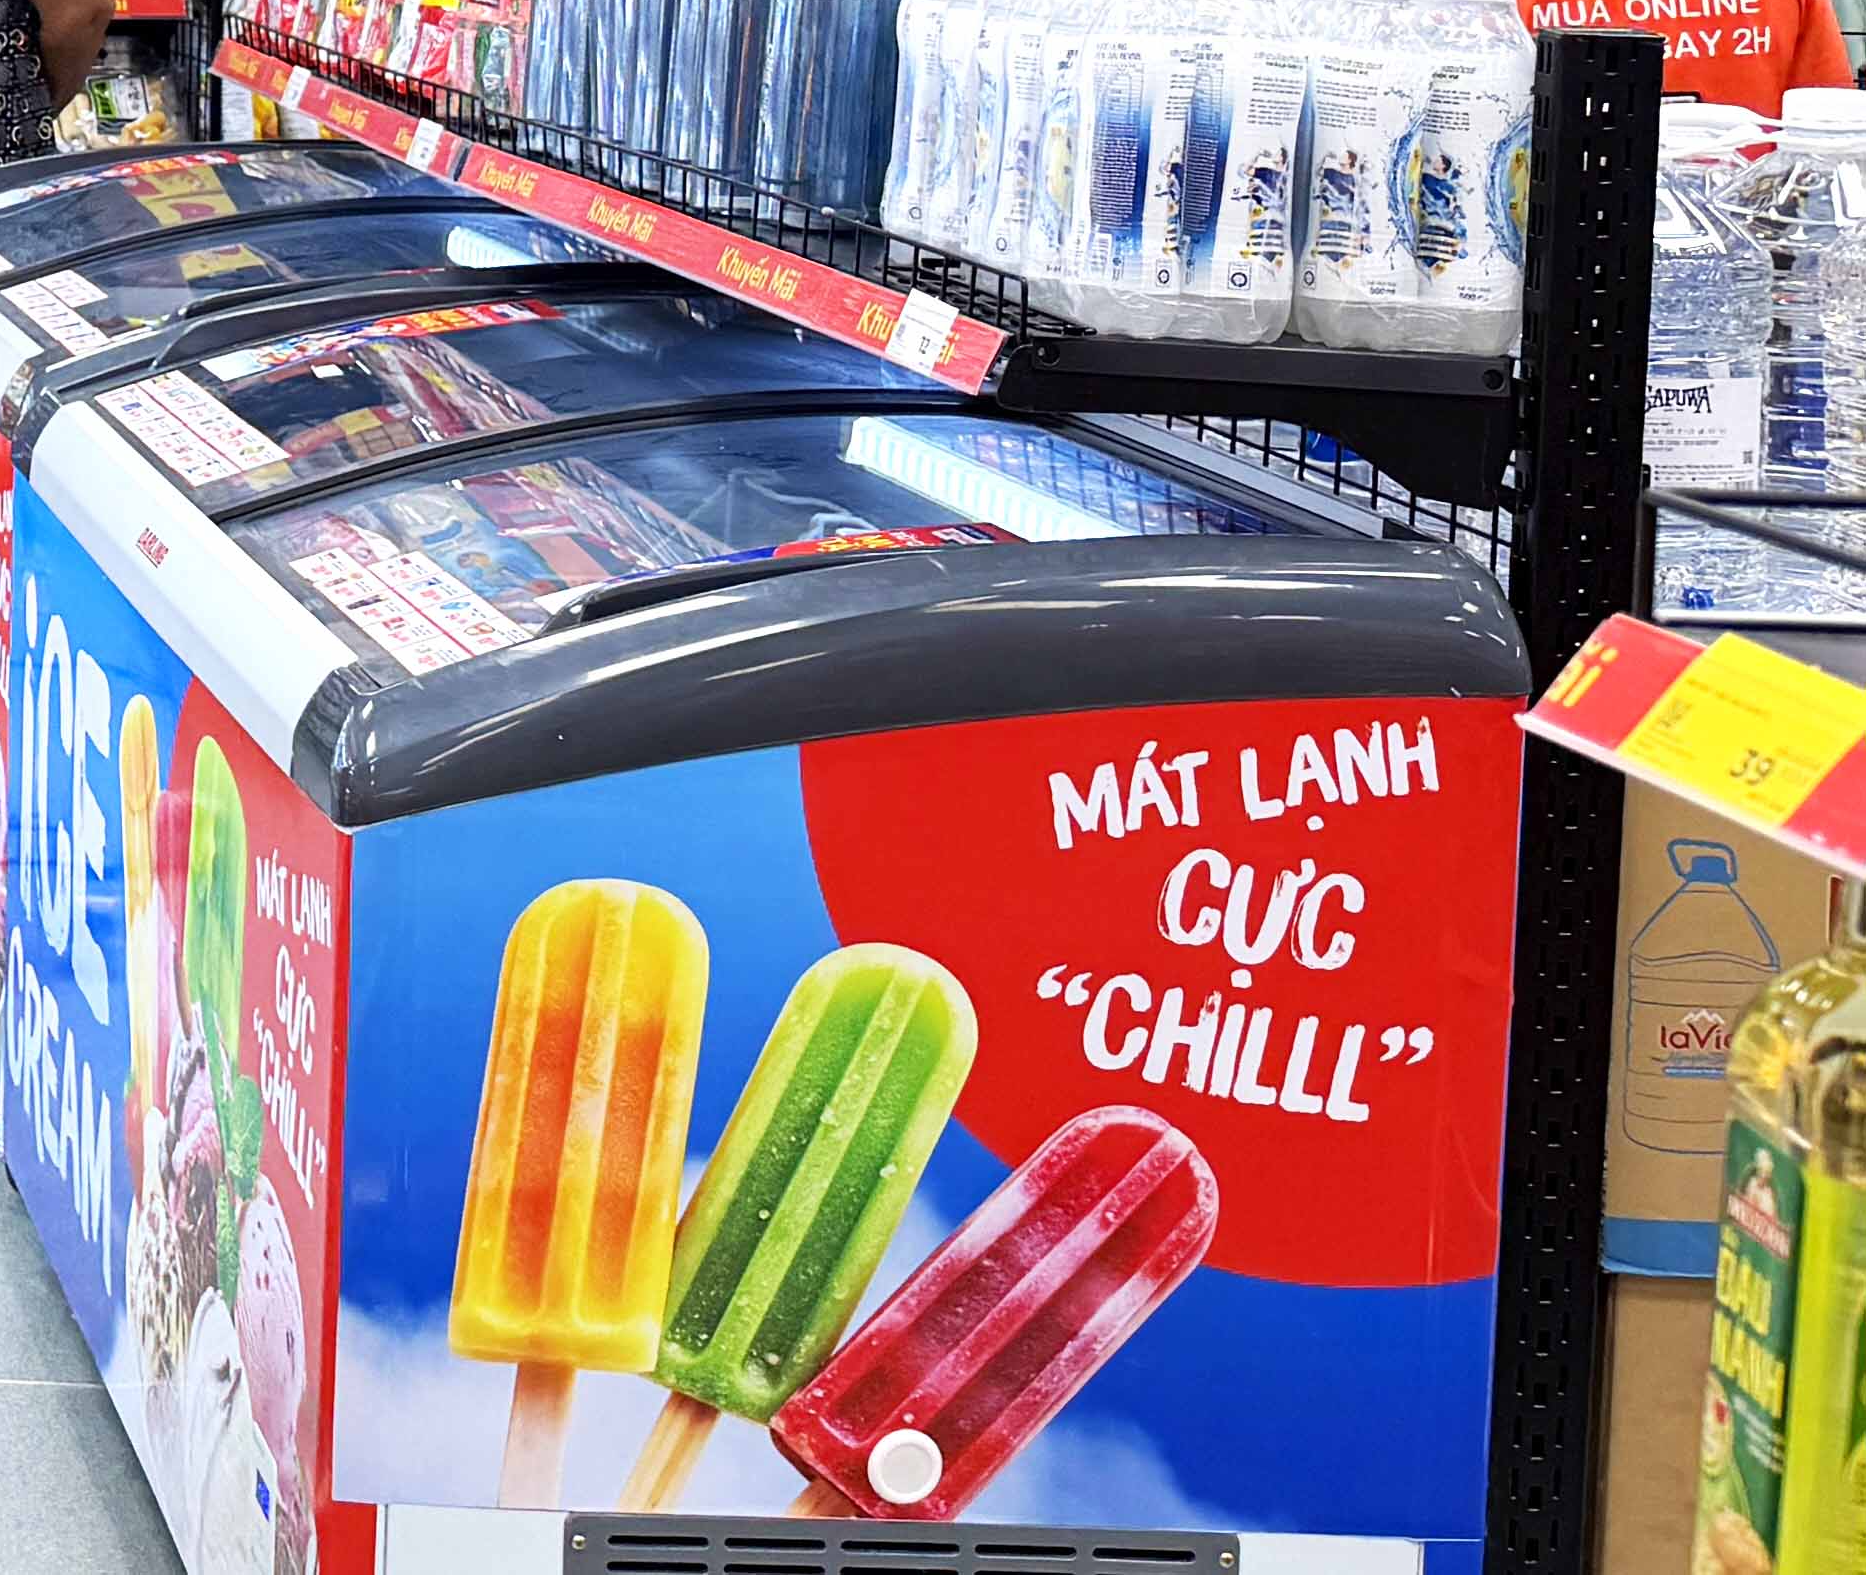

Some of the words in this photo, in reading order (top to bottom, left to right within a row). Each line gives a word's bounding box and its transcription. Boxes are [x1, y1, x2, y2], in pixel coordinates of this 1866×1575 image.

[1732, 25, 1771, 56] 2H
[587, 193, 631, 231] Khuyến
[717, 245, 768, 289] Khuyến
[769, 264, 802, 302] Mãi
[856, 299, 898, 342] Khu
[1048, 740, 1209, 849] MÁT
[1240, 716, 1439, 832] LẠNH
[1729, 749, 1775, 787] 39
[255, 848, 288, 931] MÁT
[289, 866, 332, 957] LẠNH
[1157, 848, 1366, 989] CỰC
[275, 943, 314, 1076] CỰC
[4, 926, 112, 1297] CREAM
